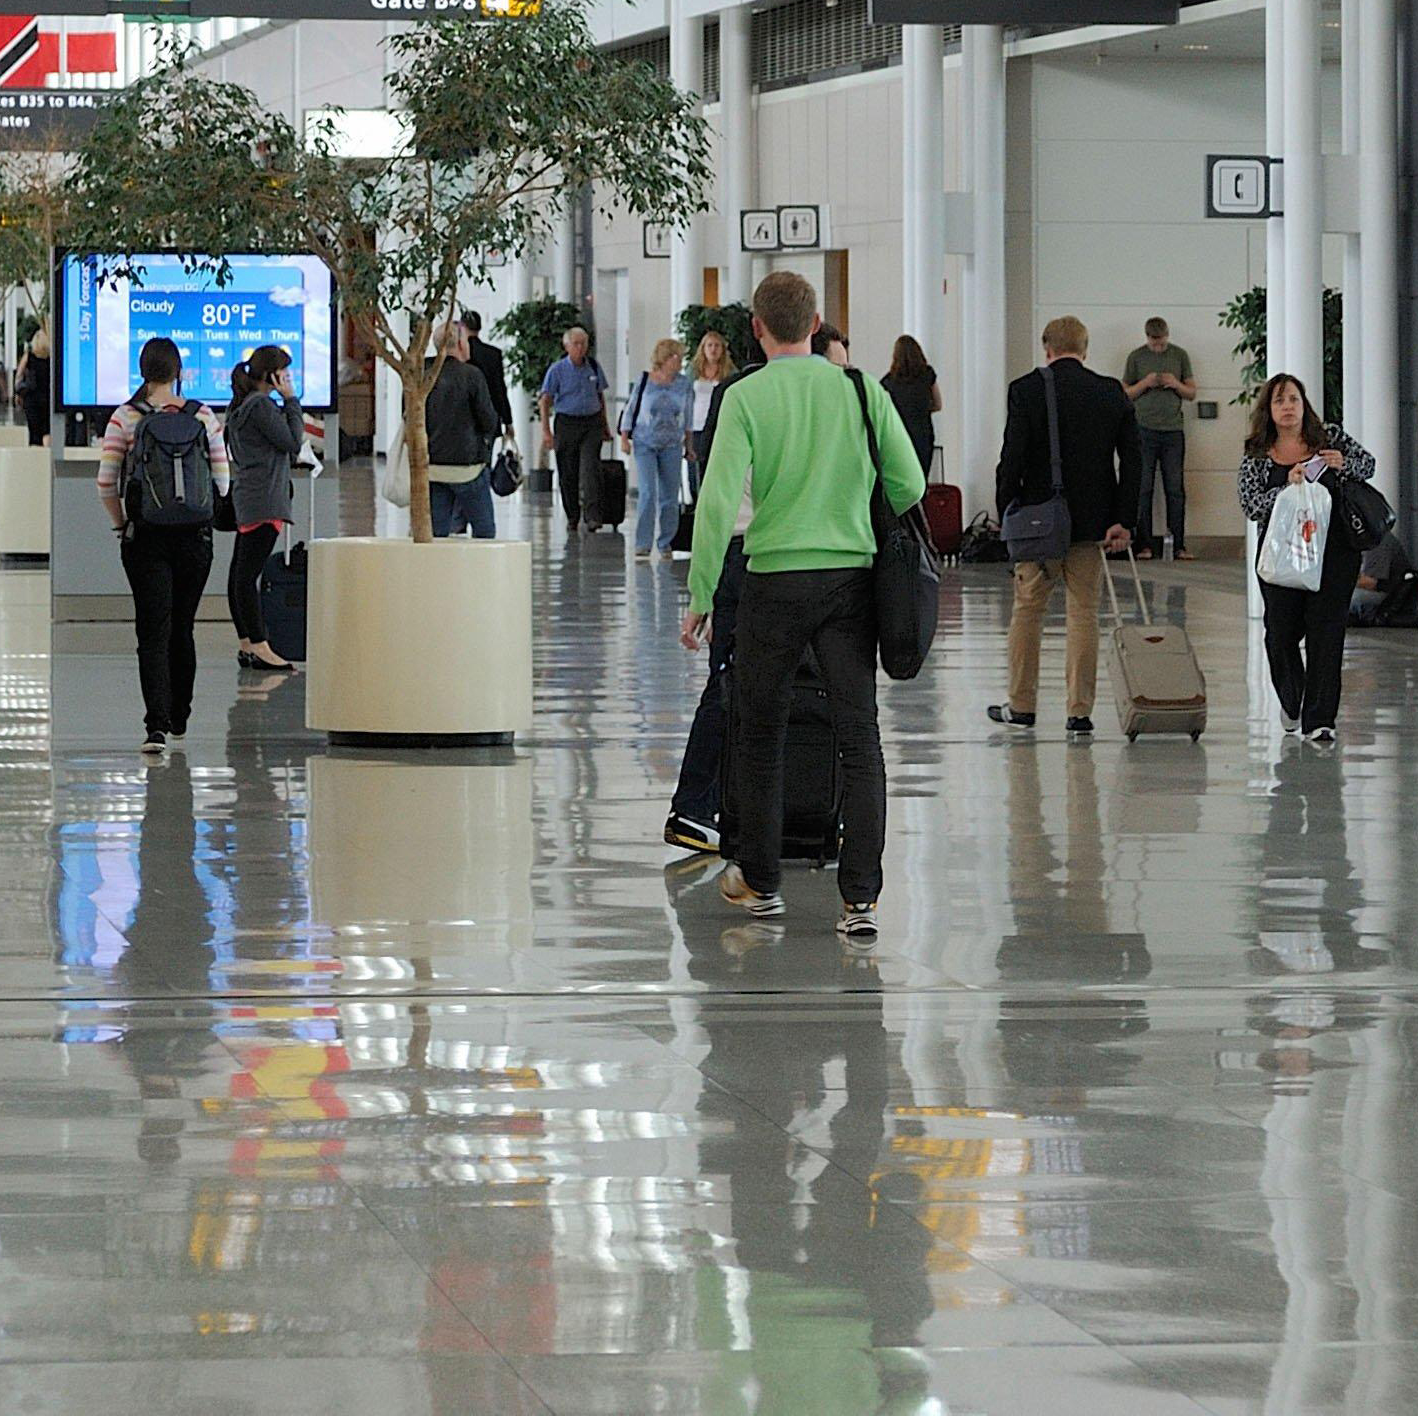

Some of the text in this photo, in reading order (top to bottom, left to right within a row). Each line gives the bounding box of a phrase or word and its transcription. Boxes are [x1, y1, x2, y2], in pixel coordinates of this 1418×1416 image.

[19, 95, 45, 109] B35
[48, 96, 64, 109] to
[130, 299, 257, 327] Cloudy 80°F
[137, 328, 300, 341] Sun Mon Tues Wed Thurs
